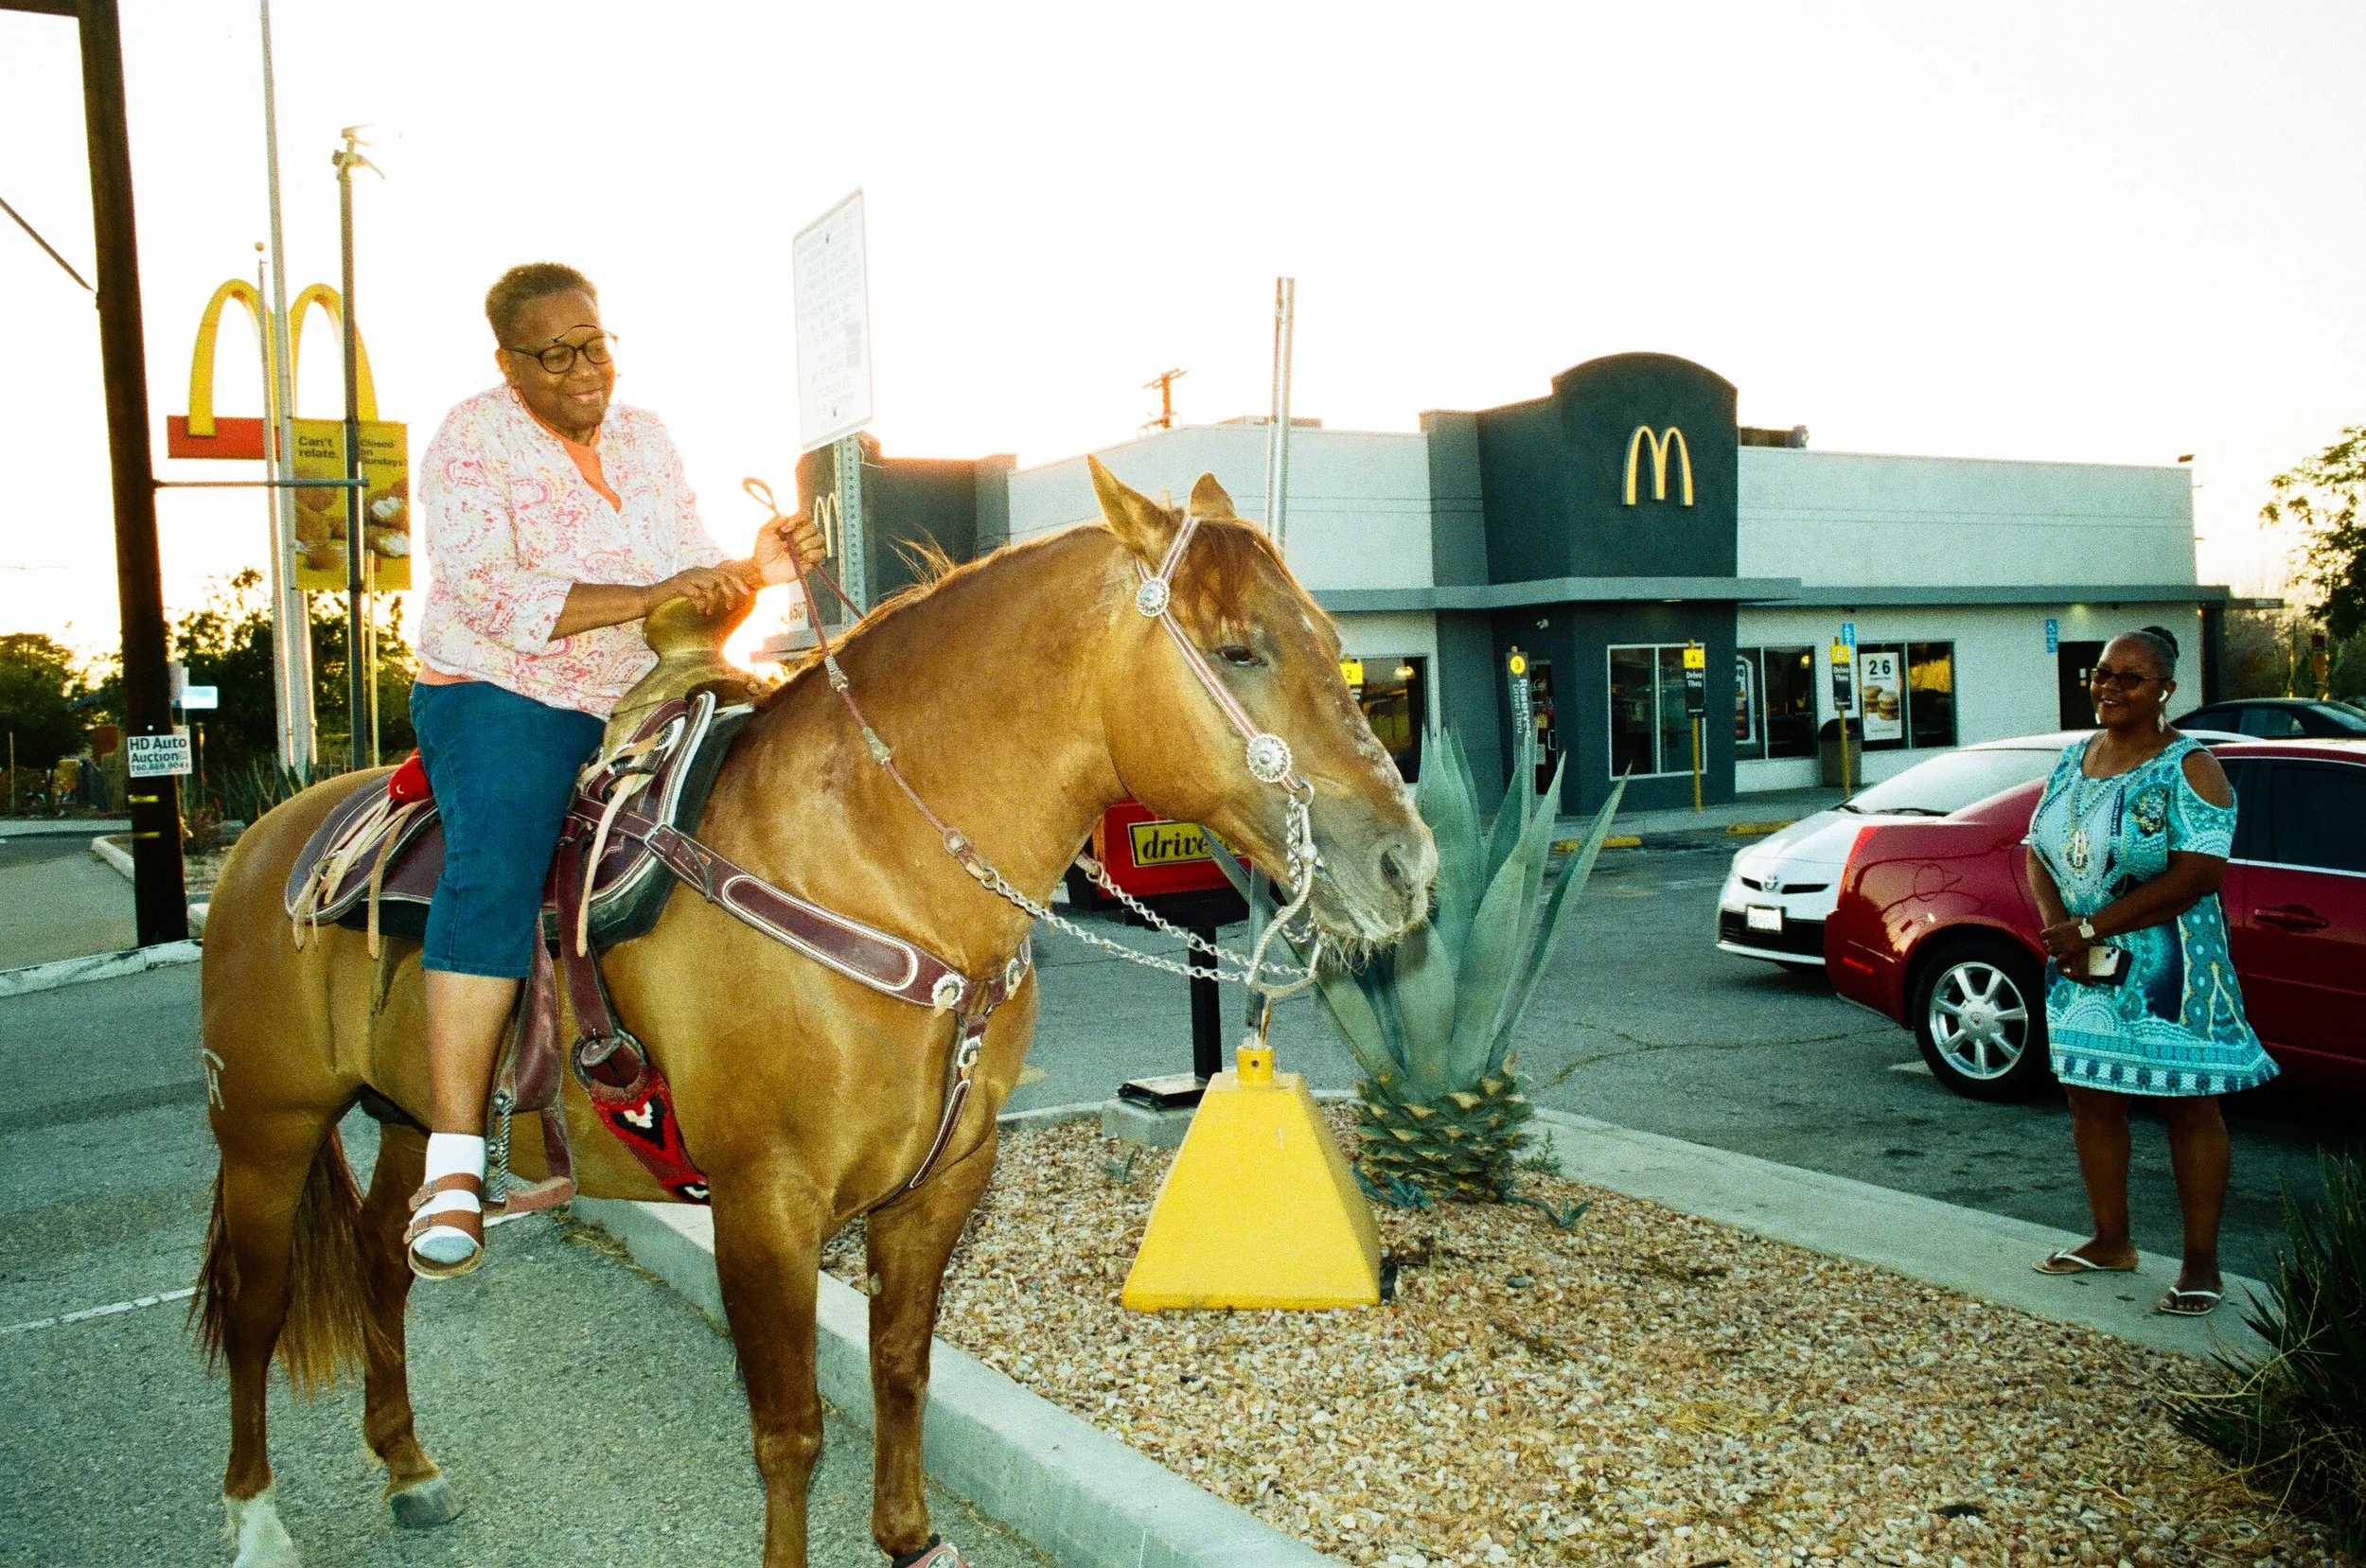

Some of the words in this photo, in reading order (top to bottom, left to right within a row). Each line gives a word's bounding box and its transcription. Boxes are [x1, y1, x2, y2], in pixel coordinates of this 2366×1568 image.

[298, 436, 332, 447] Can't
[360, 439, 394, 449] Closed
[1514, 661, 1521, 670] 3
[1346, 669, 1352, 678] 2
[1686, 671, 1703, 679] Drive
[1687, 679, 1703, 688] Thru
[130, 738, 150, 750] HD
[152, 737, 187, 749] Auto
[132, 753, 179, 763] Auction
